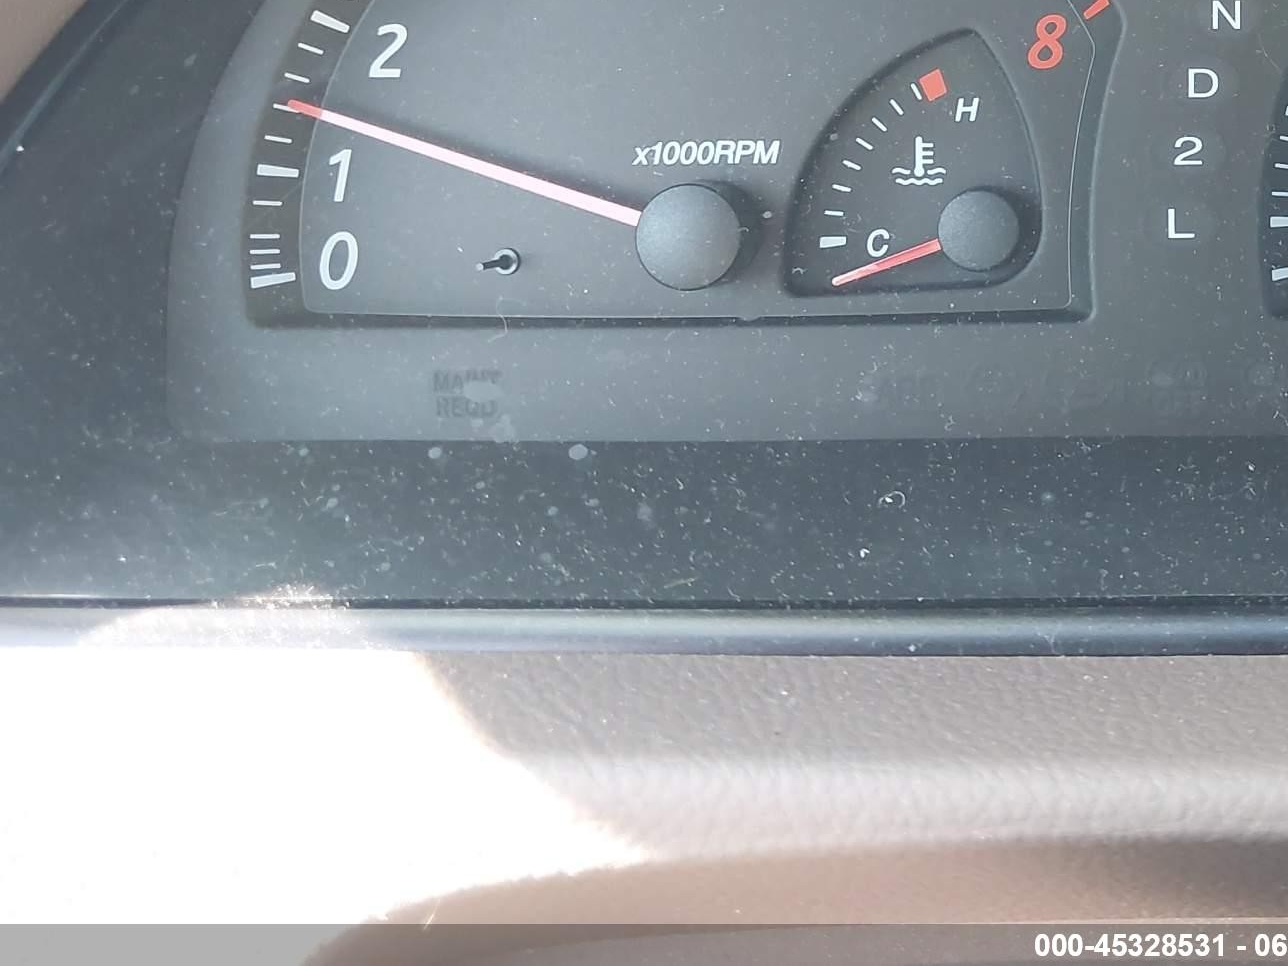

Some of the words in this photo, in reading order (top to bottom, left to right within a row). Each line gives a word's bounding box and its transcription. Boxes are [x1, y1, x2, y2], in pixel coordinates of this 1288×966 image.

[1212, 0, 1242, 30] N
[369, 24, 408, 78] 2
[1027, 14, 1067, 70] 8
[1188, 68, 1220, 98] D
[955, 97, 979, 122] H
[632, 140, 781, 166] x1000RPM
[1173, 136, 1203, 167] 2
[328, 149, 352, 201] 1
[1168, 208, 1195, 238] L
[867, 229, 890, 257] C
[318, 231, 359, 289] 0
